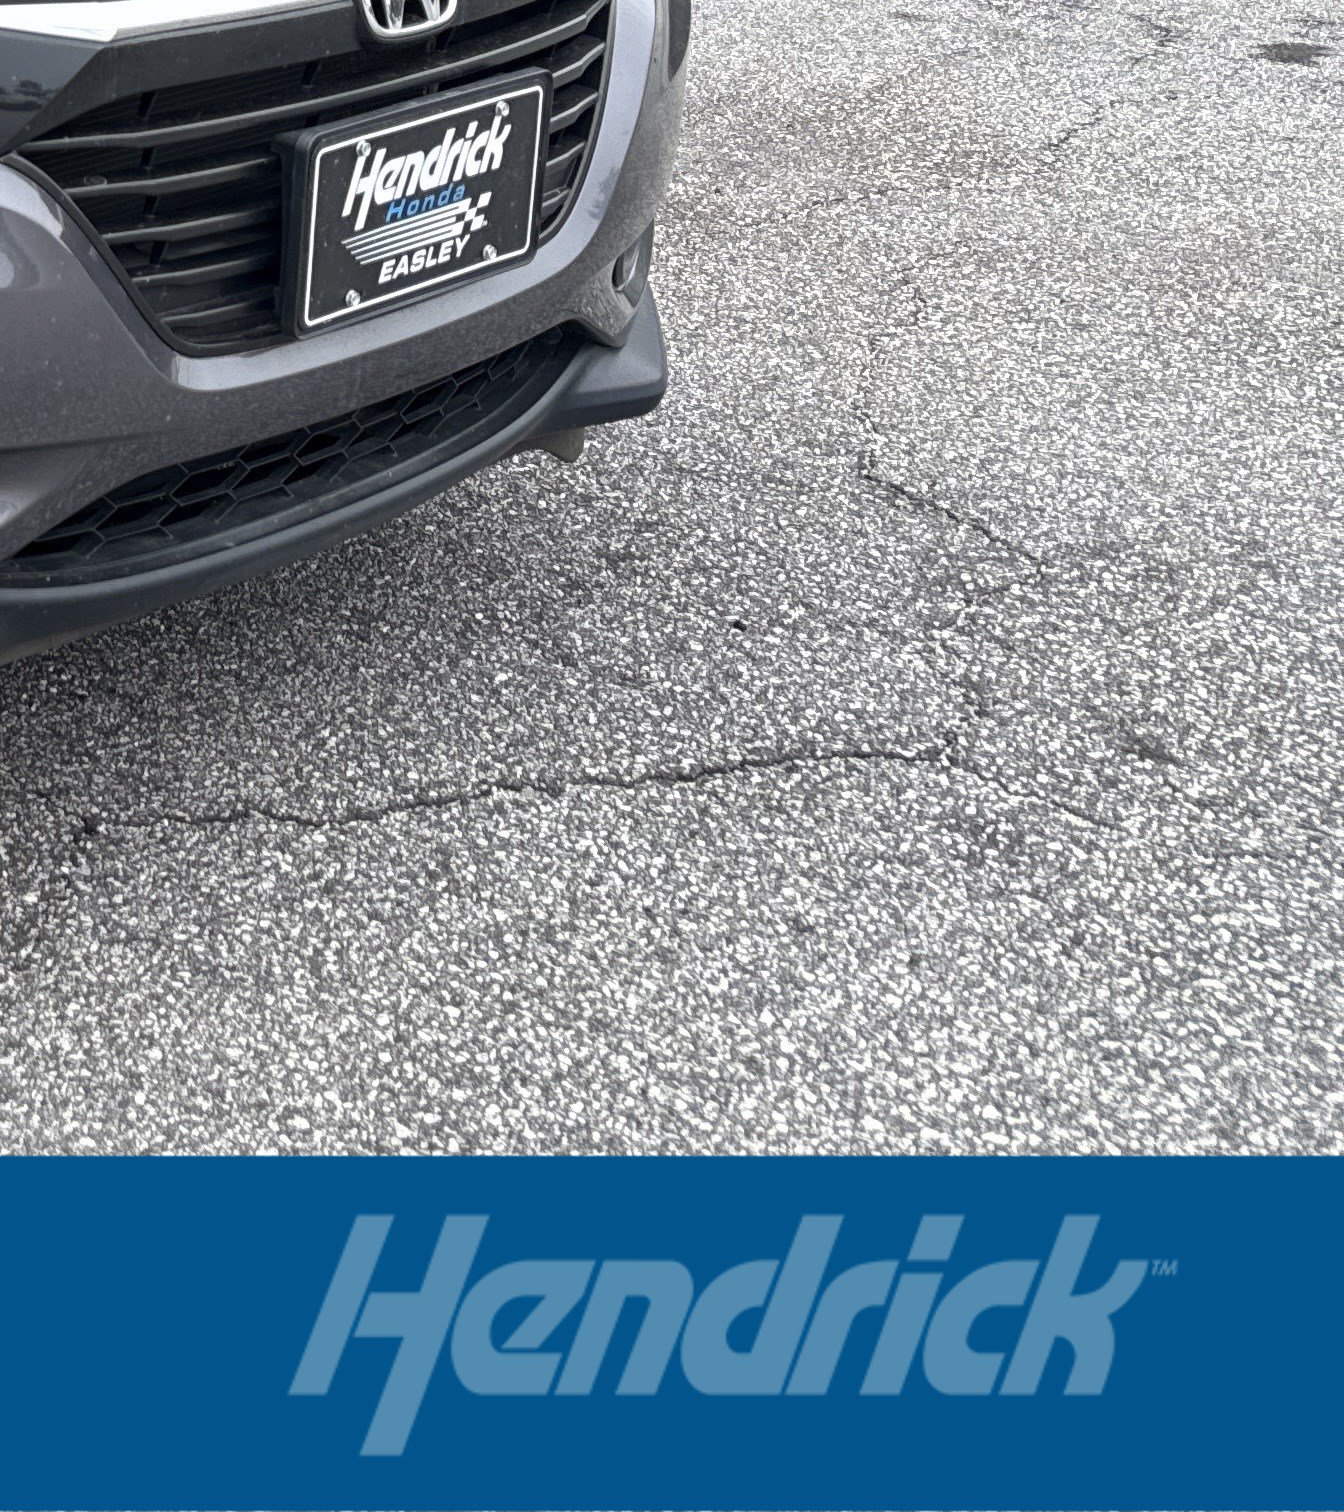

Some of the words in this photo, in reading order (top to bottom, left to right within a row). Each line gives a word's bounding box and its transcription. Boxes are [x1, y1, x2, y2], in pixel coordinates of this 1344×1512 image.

[341, 114, 512, 231] Hendrick
[385, 183, 466, 223] Honda
[377, 234, 471, 285] EASLEY
